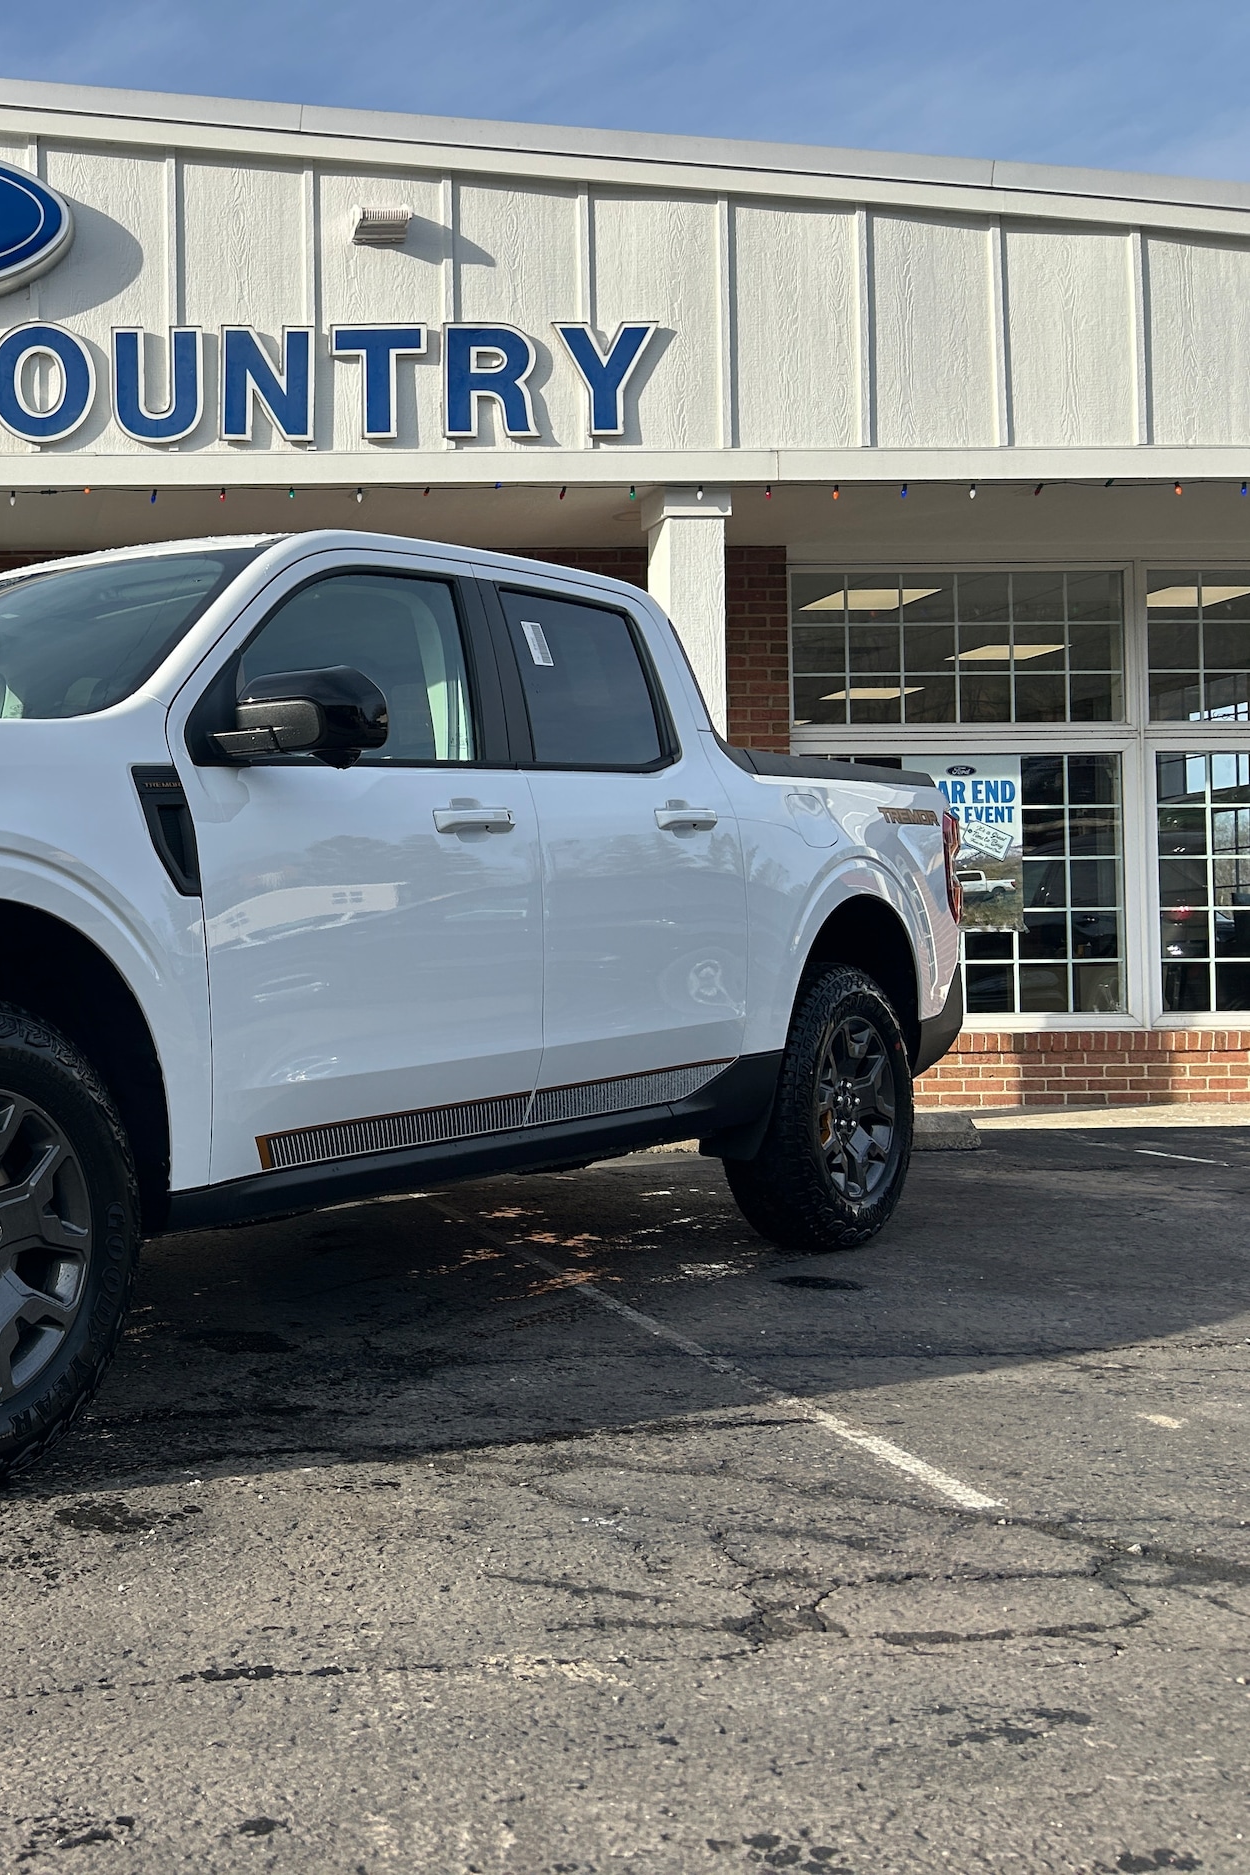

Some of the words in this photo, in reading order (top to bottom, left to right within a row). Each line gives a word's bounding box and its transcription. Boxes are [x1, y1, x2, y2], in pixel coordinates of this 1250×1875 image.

[971, 780, 1016, 804] END
[877, 806, 940, 826] TREMOR
[964, 806, 1015, 823] EVENT
[7, 1201, 128, 1440] GOODYEAR
